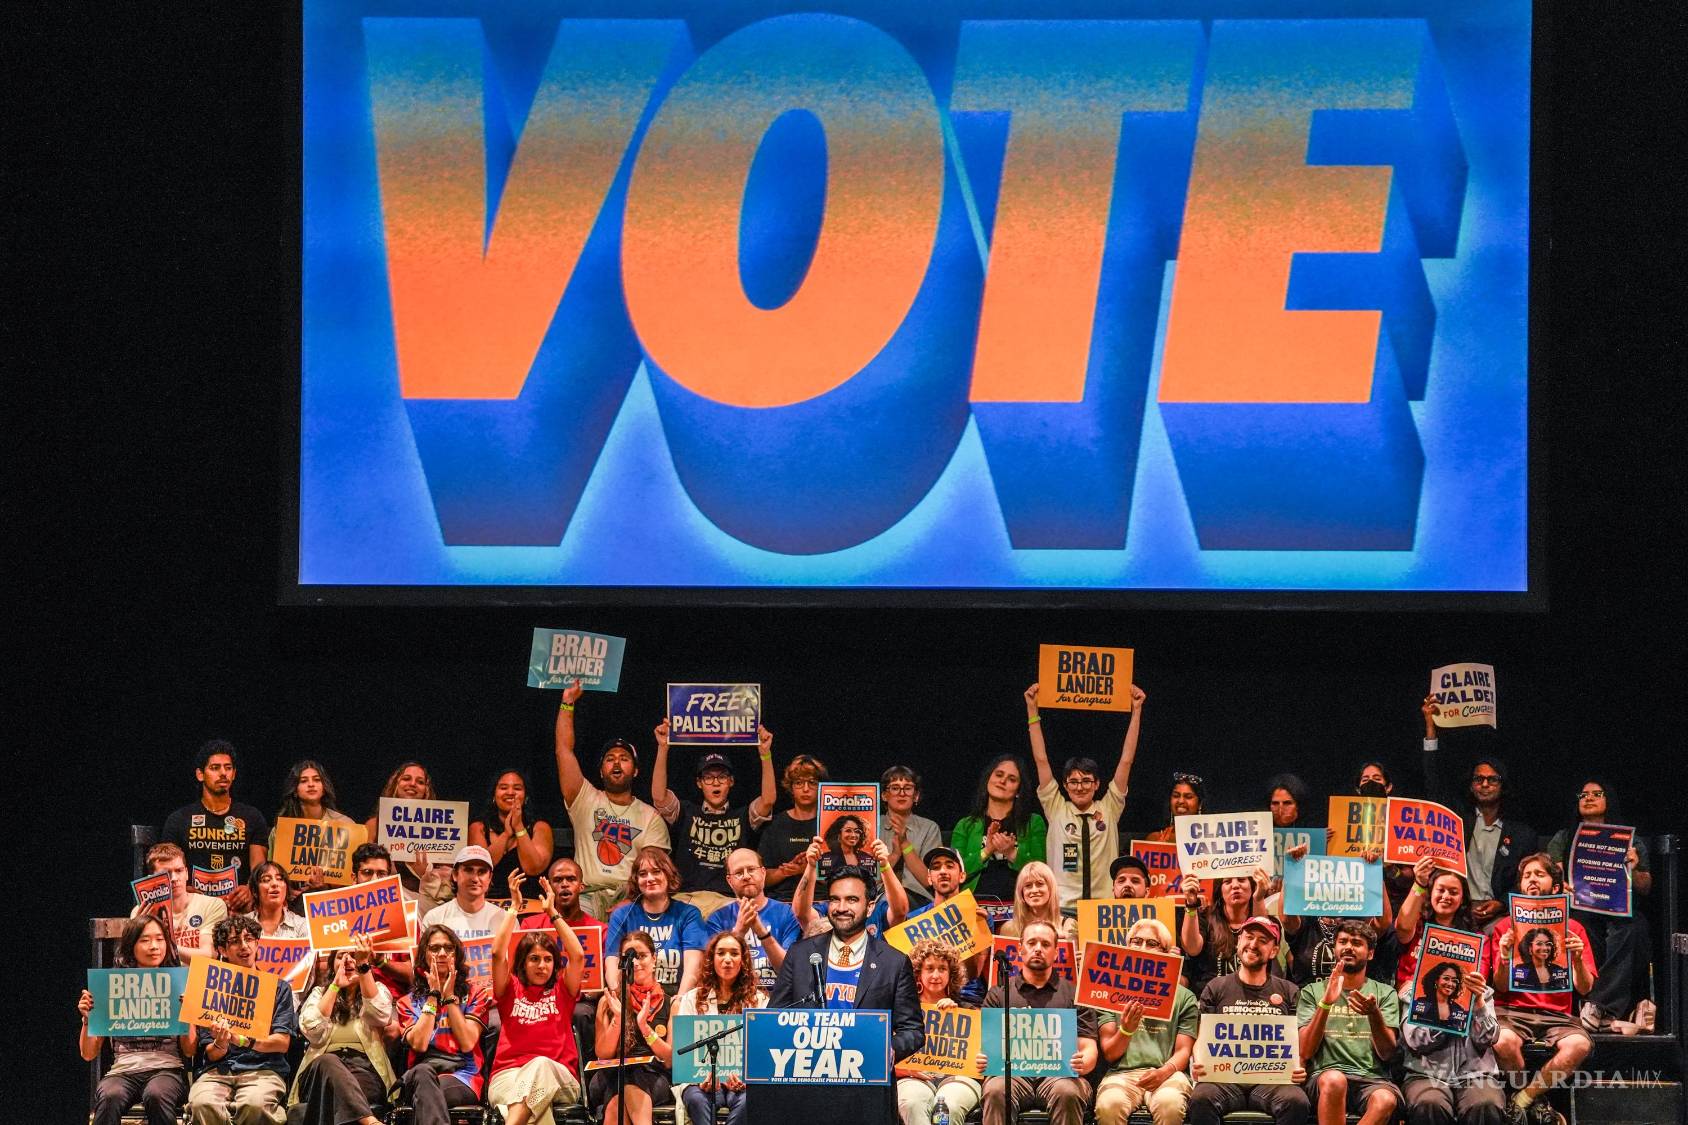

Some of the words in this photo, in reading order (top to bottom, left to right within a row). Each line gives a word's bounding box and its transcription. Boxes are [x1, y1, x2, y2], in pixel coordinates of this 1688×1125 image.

[362, 12, 1426, 409] VOTE
[552, 634, 608, 658] BRAD
[548, 656, 604, 677] LANDER
[1058, 650, 1115, 676] BRAD
[548, 675, 562, 685] for
[1057, 674, 1114, 696] LANDER
[1441, 670, 1490, 688] CLAIRE
[686, 693, 742, 712] FREE
[1056, 694, 1072, 703] for
[1073, 694, 1112, 706] Congress
[1435, 689, 1494, 704] VALDEZ
[1444, 709, 1459, 719] FOR
[672, 716, 756, 732] PALESTINE
[824, 794, 872, 806] Darializa
[392, 806, 455, 824] CLAIRE
[1348, 802, 1386, 825] BRA
[1401, 806, 1457, 834] CLAIRE
[294, 824, 349, 849] BRAD
[386, 824, 461, 840] VALDEZ
[595, 819, 632, 847] ICE
[690, 824, 741, 846] NIOU
[1190, 820, 1259, 839] CLAIRE
[1346, 824, 1386, 844] LAND
[1393, 825, 1463, 853] VALDEZ
[189, 841, 245, 850] MOVEMENT
[390, 844, 405, 852] FOR
[407, 842, 456, 853] CONGRESS
[1184, 839, 1267, 856] VALDEZ
[1274, 832, 1311, 856] RAD
[1398, 845, 1414, 854] FOR
[1415, 844, 1459, 862] CONGRESS
[290, 847, 346, 870] LANDER
[1136, 850, 1180, 869] MEDI
[1192, 860, 1208, 870] FOR
[1210, 855, 1262, 870] CONGRESS
[288, 867, 302, 876] for
[1150, 873, 1167, 886] OR
[1304, 859, 1364, 884] BRAD
[310, 886, 399, 918] MEDICARE
[1304, 883, 1364, 902] LANDER
[1098, 905, 1157, 928] BRAD
[1304, 902, 1320, 911] for
[1322, 902, 1363, 912] Congress
[1516, 906, 1562, 919] Darializa
[323, 919, 348, 935] FOR
[350, 909, 390, 937] ALL
[904, 903, 963, 947] BRAD
[455, 929, 490, 938] LAIRE
[256, 946, 311, 963] DICAR
[1429, 938, 1476, 957] Darializa
[1097, 951, 1167, 978] CLAIRE
[108, 973, 171, 999] BRAD
[206, 964, 259, 999] BRAD
[1088, 968, 1172, 997] VALDEZ
[201, 988, 256, 1021] LANDER
[1091, 990, 1109, 999] FOR
[1110, 992, 1163, 1007] CONGRESS
[109, 998, 171, 1020] LANDER
[198, 1010, 214, 1022] for
[1222, 1006, 1282, 1015] DEMOCRATIC
[108, 1020, 126, 1031] for
[127, 1020, 169, 1032] Congress
[778, 1012, 809, 1026] OUR
[814, 1012, 856, 1026] TEAM
[1002, 1013, 1062, 1039] BRAD
[693, 1020, 743, 1046] BRA
[793, 1026, 842, 1049] OUR
[1215, 1023, 1285, 1041] CLAIRE
[1207, 1043, 1292, 1059] VALDEZ
[769, 1048, 864, 1078] YEAR
[906, 1056, 922, 1065] for
[924, 1057, 964, 1070] Congress
[1020, 1061, 1061, 1075] Congress
[1213, 1062, 1231, 1072] FOR
[1234, 1061, 1287, 1074] CONGRESS
